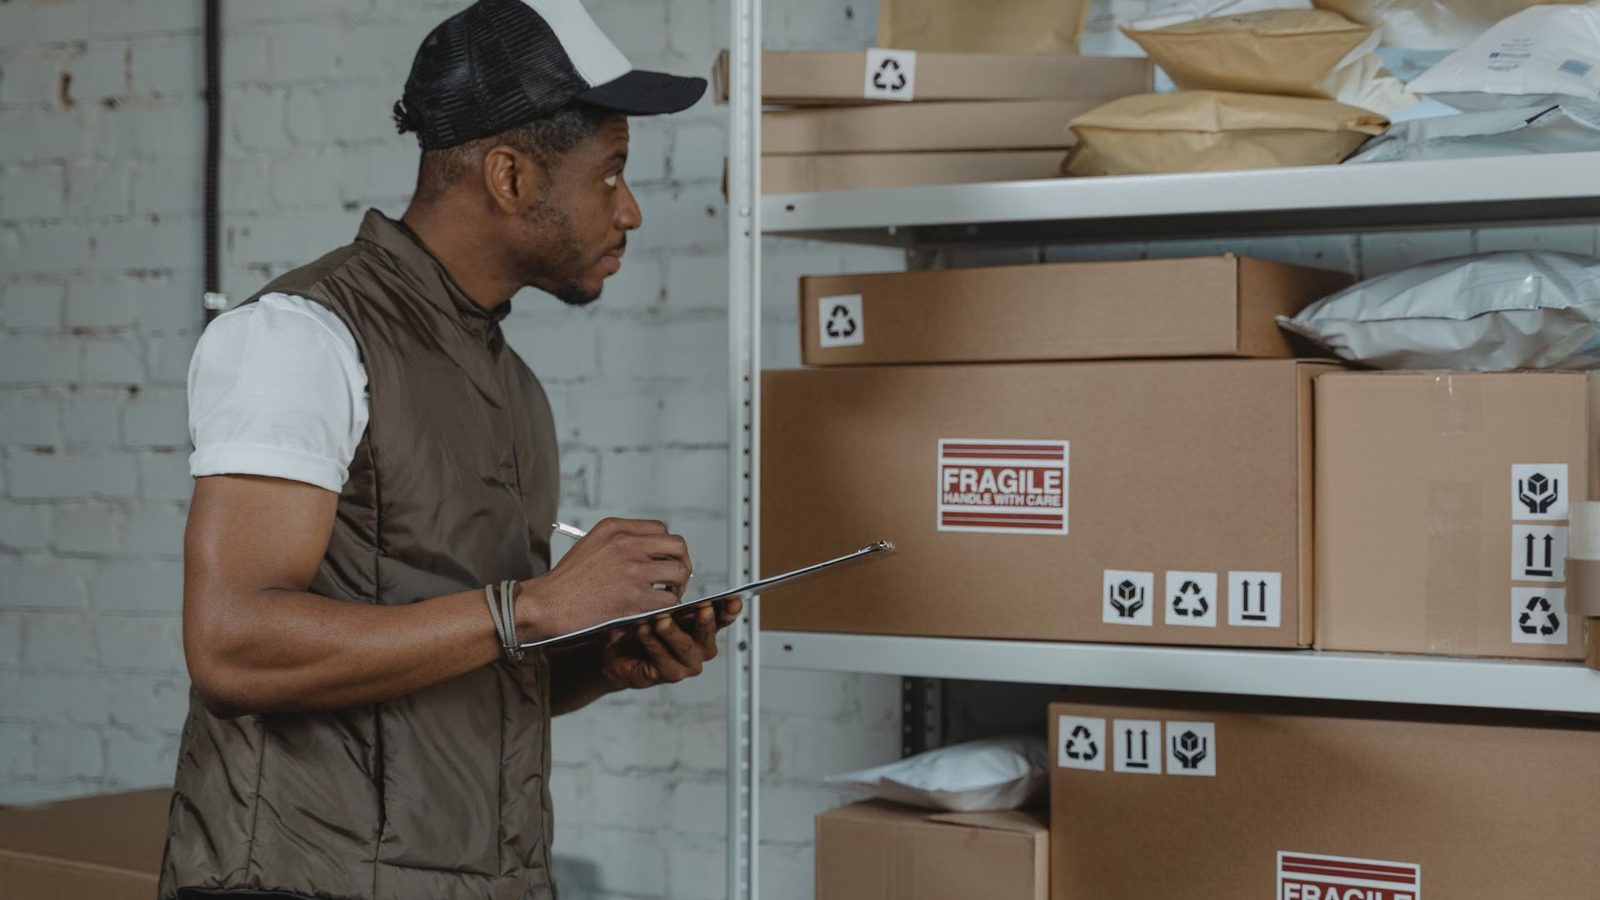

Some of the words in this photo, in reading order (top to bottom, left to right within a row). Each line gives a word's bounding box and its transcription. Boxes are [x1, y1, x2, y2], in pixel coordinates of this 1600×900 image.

[943, 468, 1062, 494] FRAGILE
[943, 493, 992, 505] HANDLE
[994, 493, 1025, 506] WITH
[1026, 494, 1061, 507] CARE
